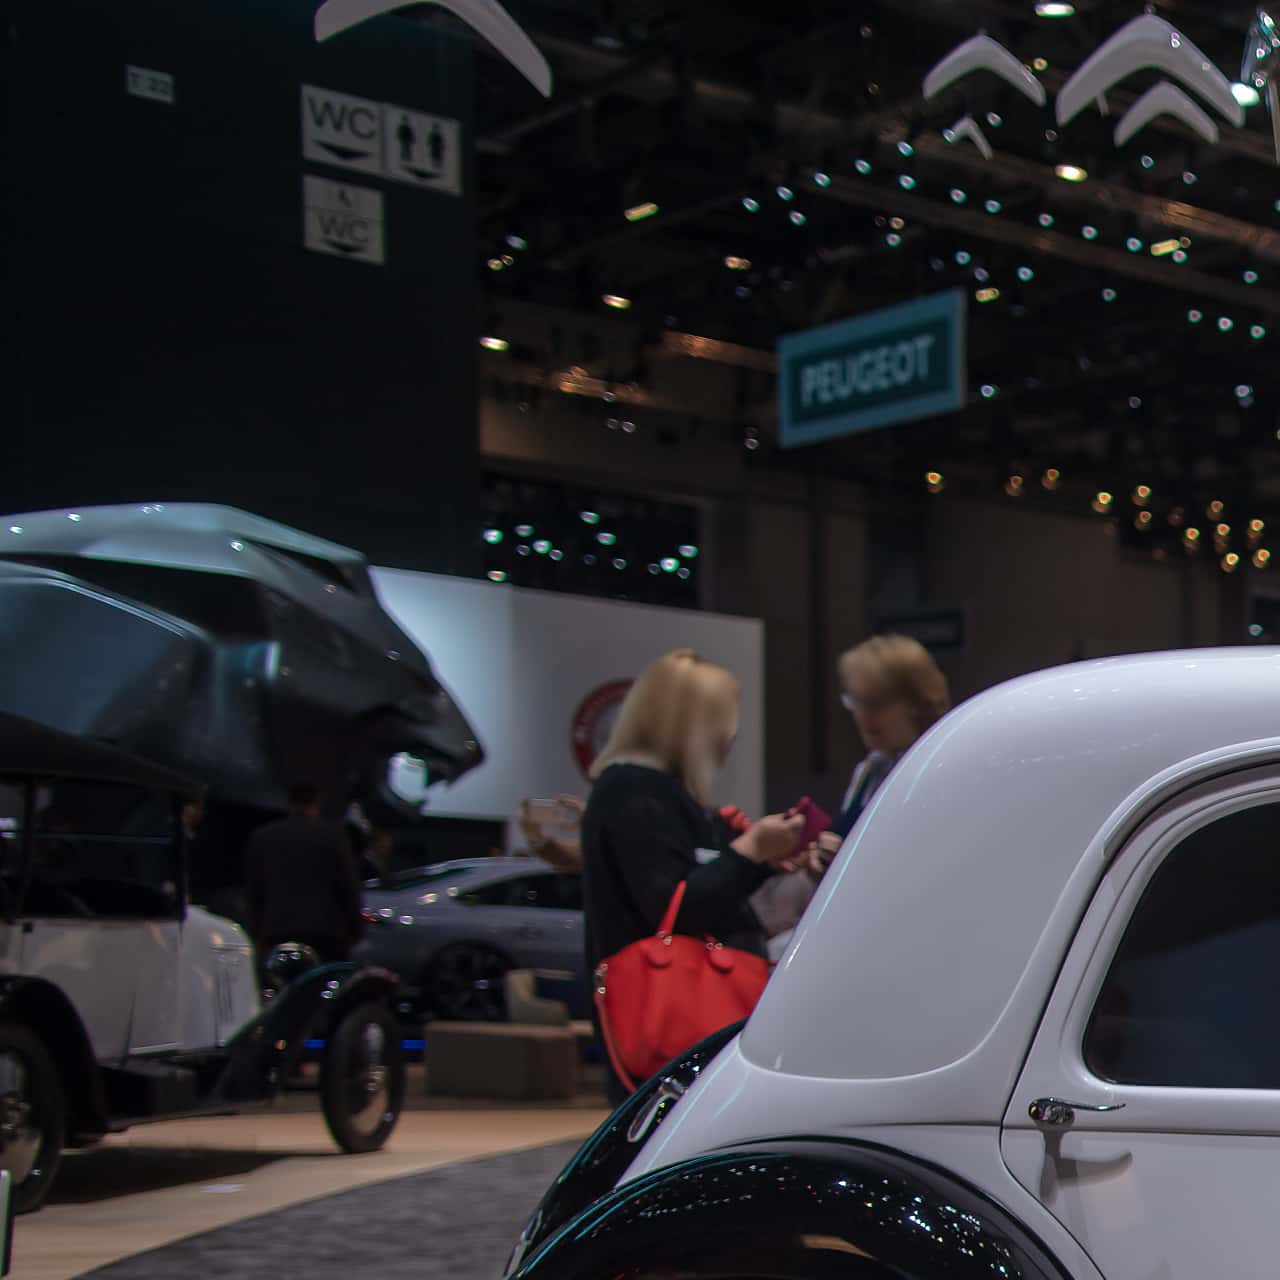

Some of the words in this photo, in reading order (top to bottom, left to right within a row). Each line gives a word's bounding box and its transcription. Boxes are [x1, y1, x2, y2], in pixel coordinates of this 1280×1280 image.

[308, 95, 377, 140] WC
[316, 213, 370, 242] WC
[801, 334, 936, 408] PEUGEOT
